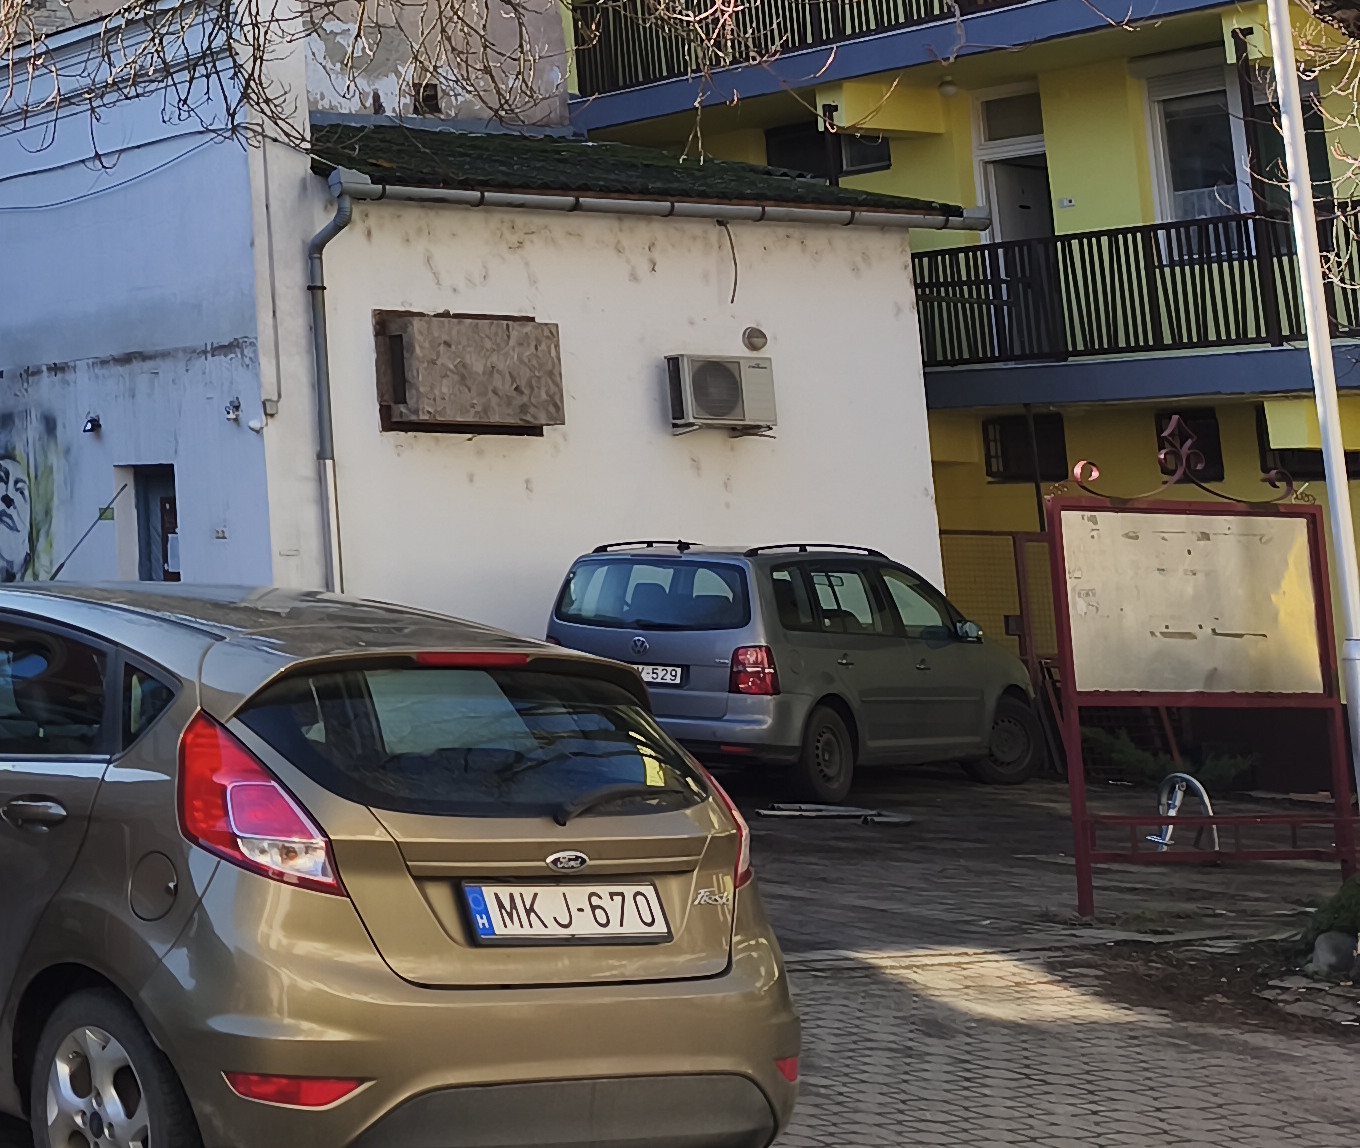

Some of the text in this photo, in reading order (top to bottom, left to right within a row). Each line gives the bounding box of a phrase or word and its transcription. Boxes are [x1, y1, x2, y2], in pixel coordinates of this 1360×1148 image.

[557, 855, 582, 868] Ford
[476, 890, 657, 929] H MKJ-670
